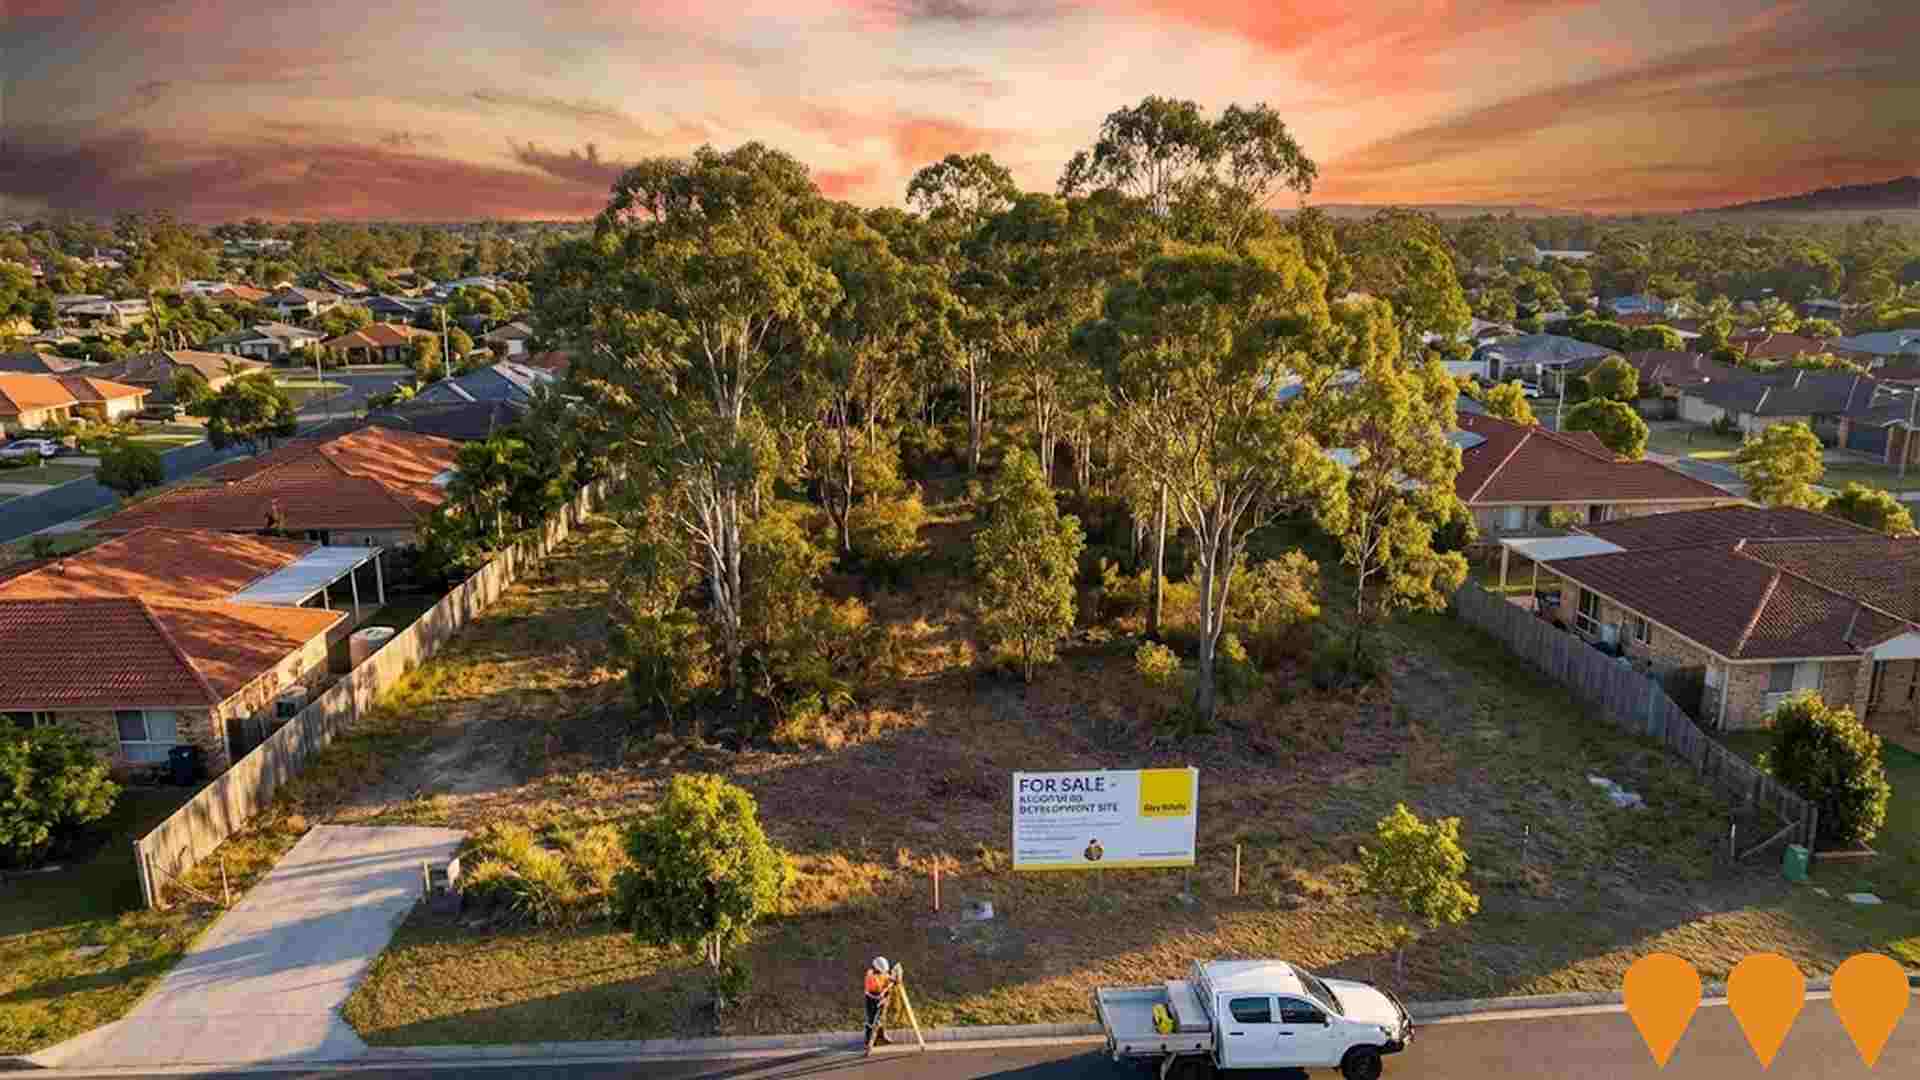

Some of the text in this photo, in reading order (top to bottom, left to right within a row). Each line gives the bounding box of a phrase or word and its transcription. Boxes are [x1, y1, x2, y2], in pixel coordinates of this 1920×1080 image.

[1019, 778, 1056, 793] FOR
[1061, 776, 1105, 792] SALE
[1097, 802, 1118, 812] SITE
